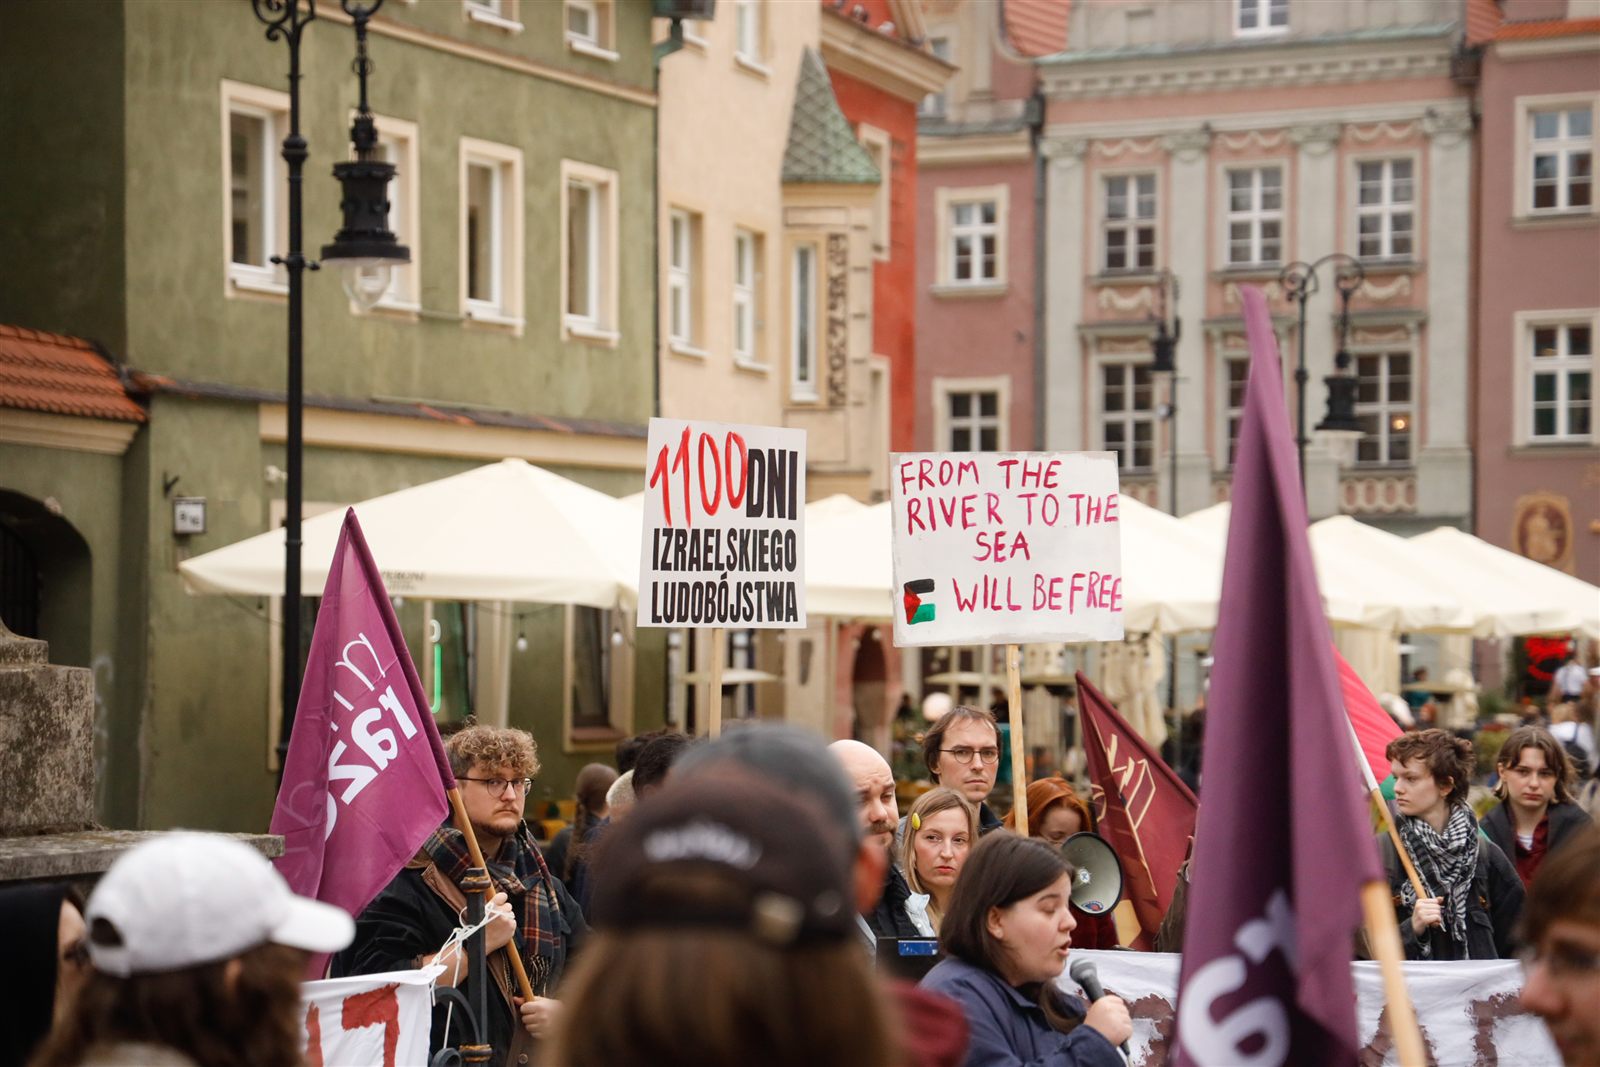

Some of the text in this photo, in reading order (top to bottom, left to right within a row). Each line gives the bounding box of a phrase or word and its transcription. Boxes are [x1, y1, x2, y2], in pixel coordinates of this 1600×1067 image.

[649, 425, 798, 529] 1100 DNI
[901, 459, 1062, 495] FROM THE
[907, 492, 1118, 535] RIVER TO THE
[652, 528, 797, 572] IZRAELSKIEGO
[973, 531, 1031, 563] SEA
[651, 571, 798, 624] LUDOBÓJSTWA
[952, 571, 1122, 615] WILL BE FREE
